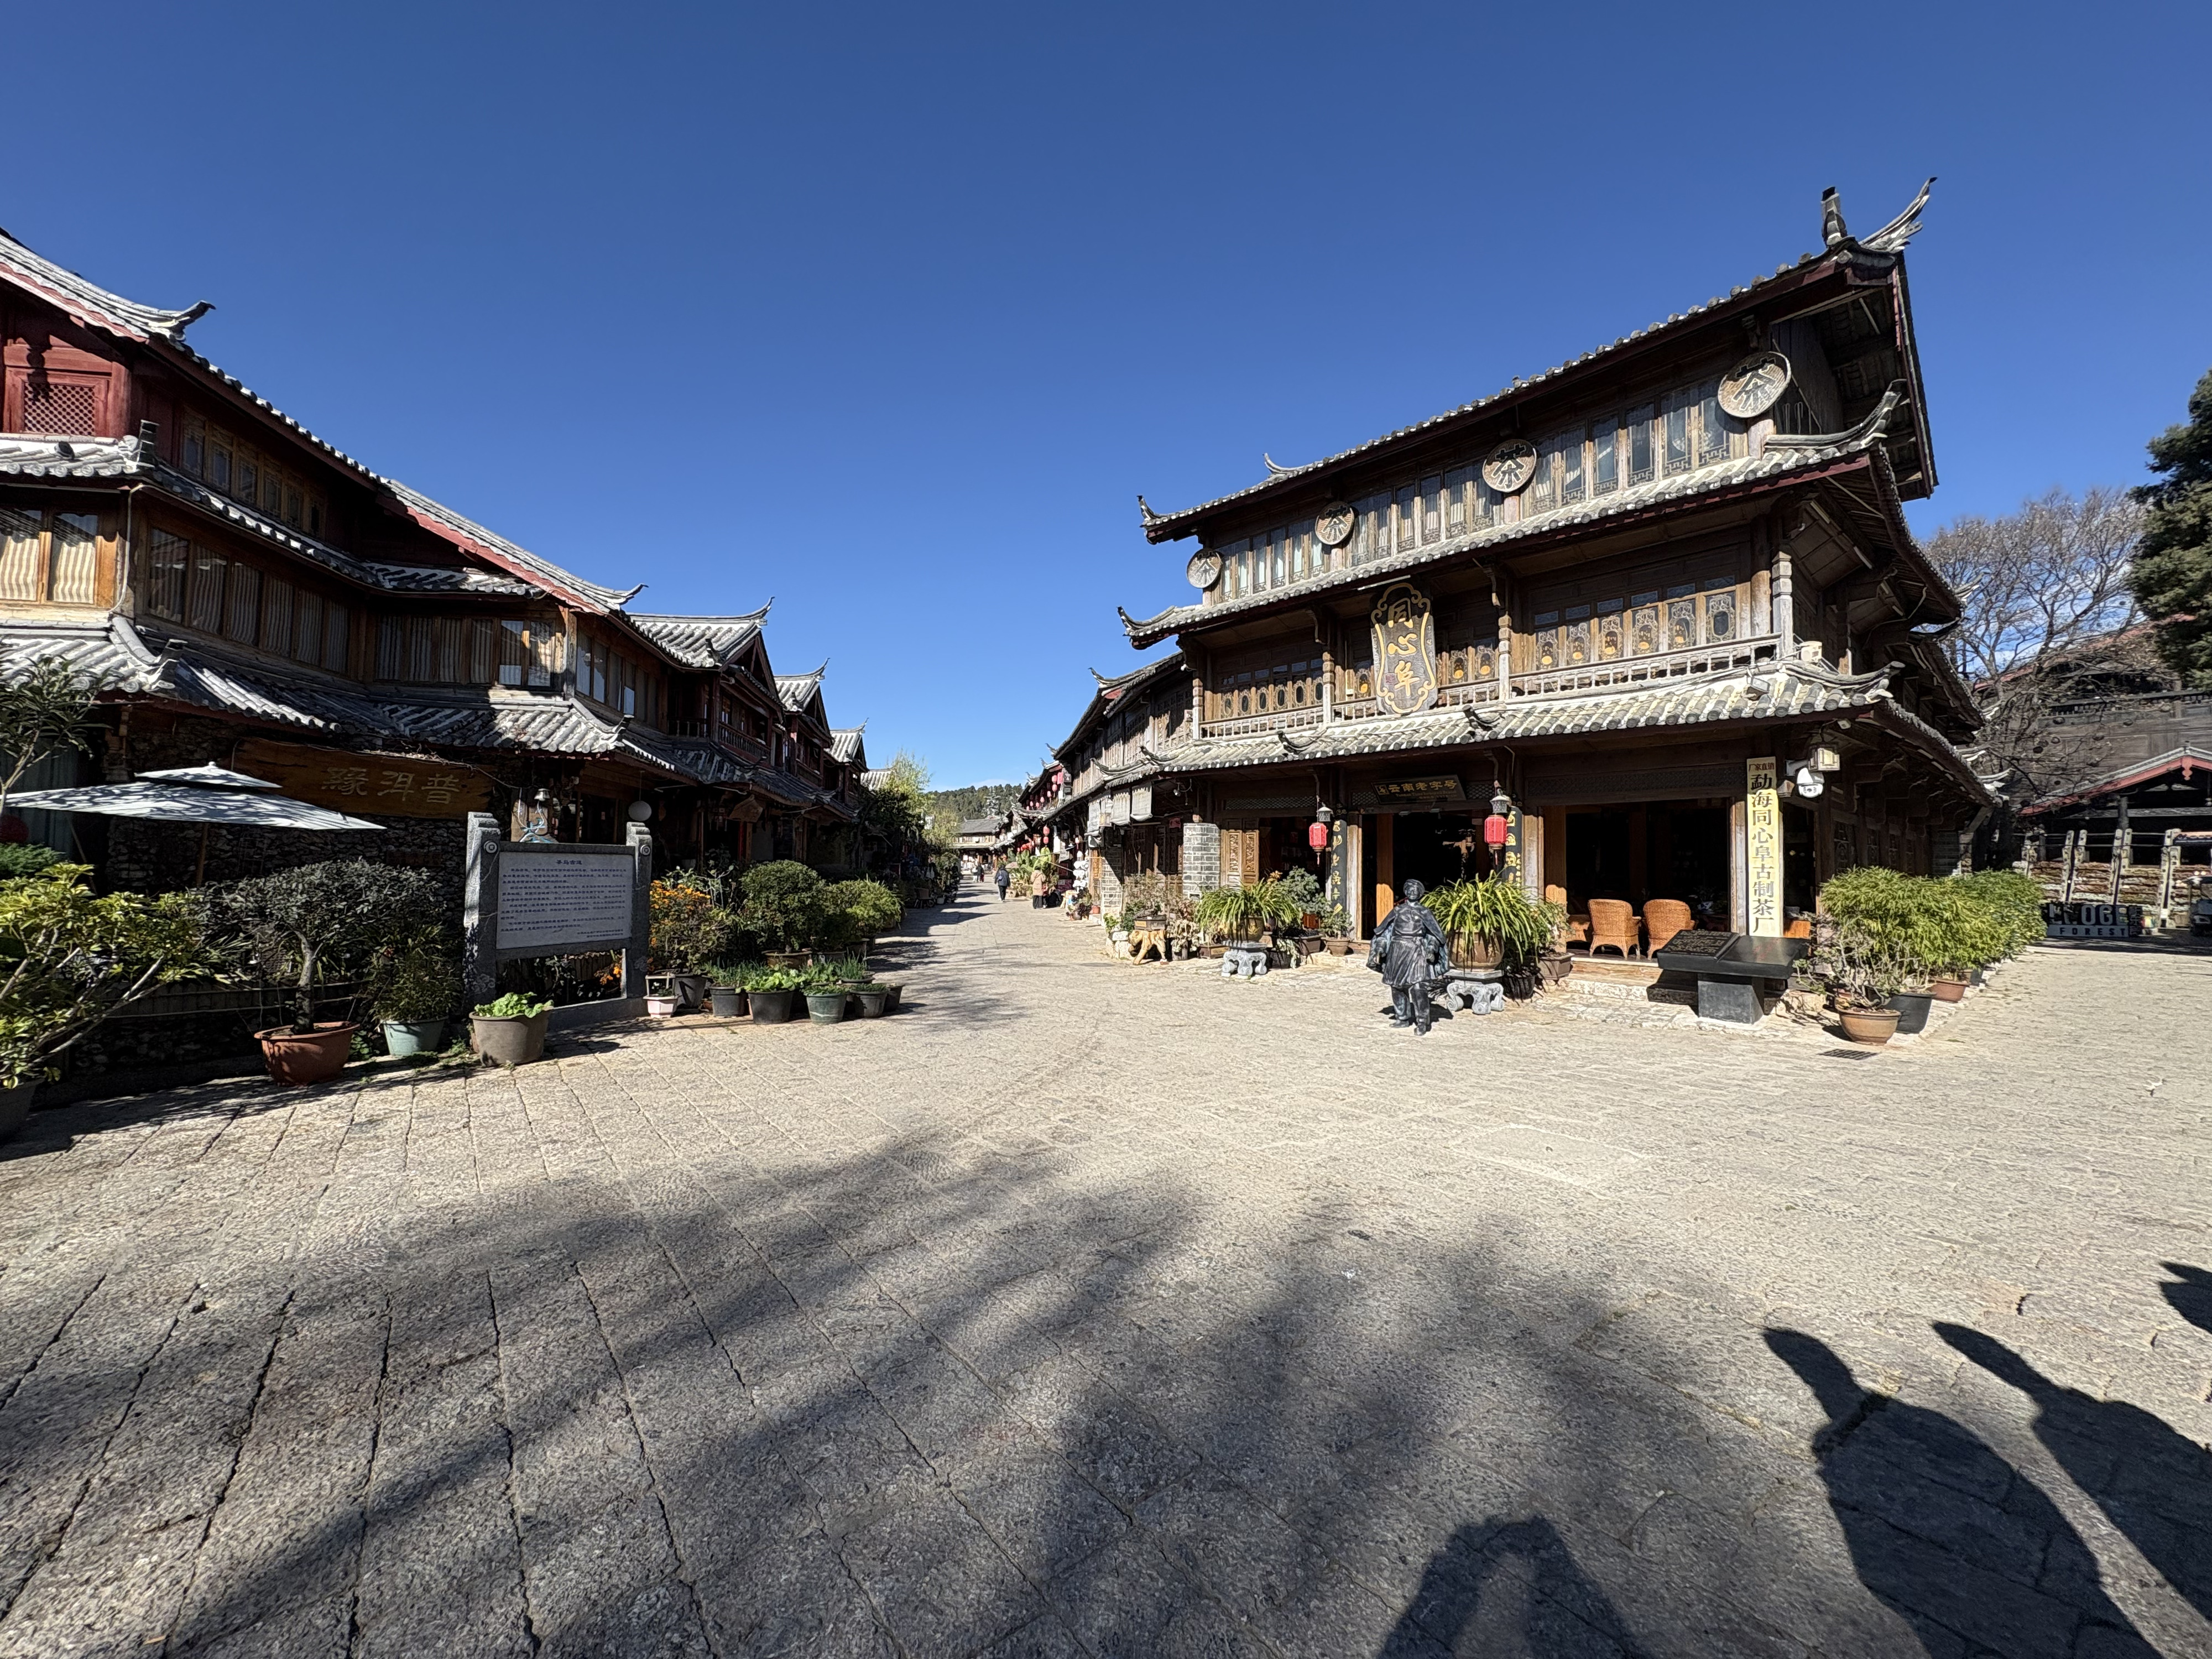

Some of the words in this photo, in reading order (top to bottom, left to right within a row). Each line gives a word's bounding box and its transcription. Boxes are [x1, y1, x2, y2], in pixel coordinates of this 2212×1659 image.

[1749, 761, 1775, 772] 厂家直销
[1387, 780, 1458, 793] 云南老字号
[1750, 773, 1775, 933] 勐海同心阜古制茶厂
[2059, 927, 2126, 936] FOREST
